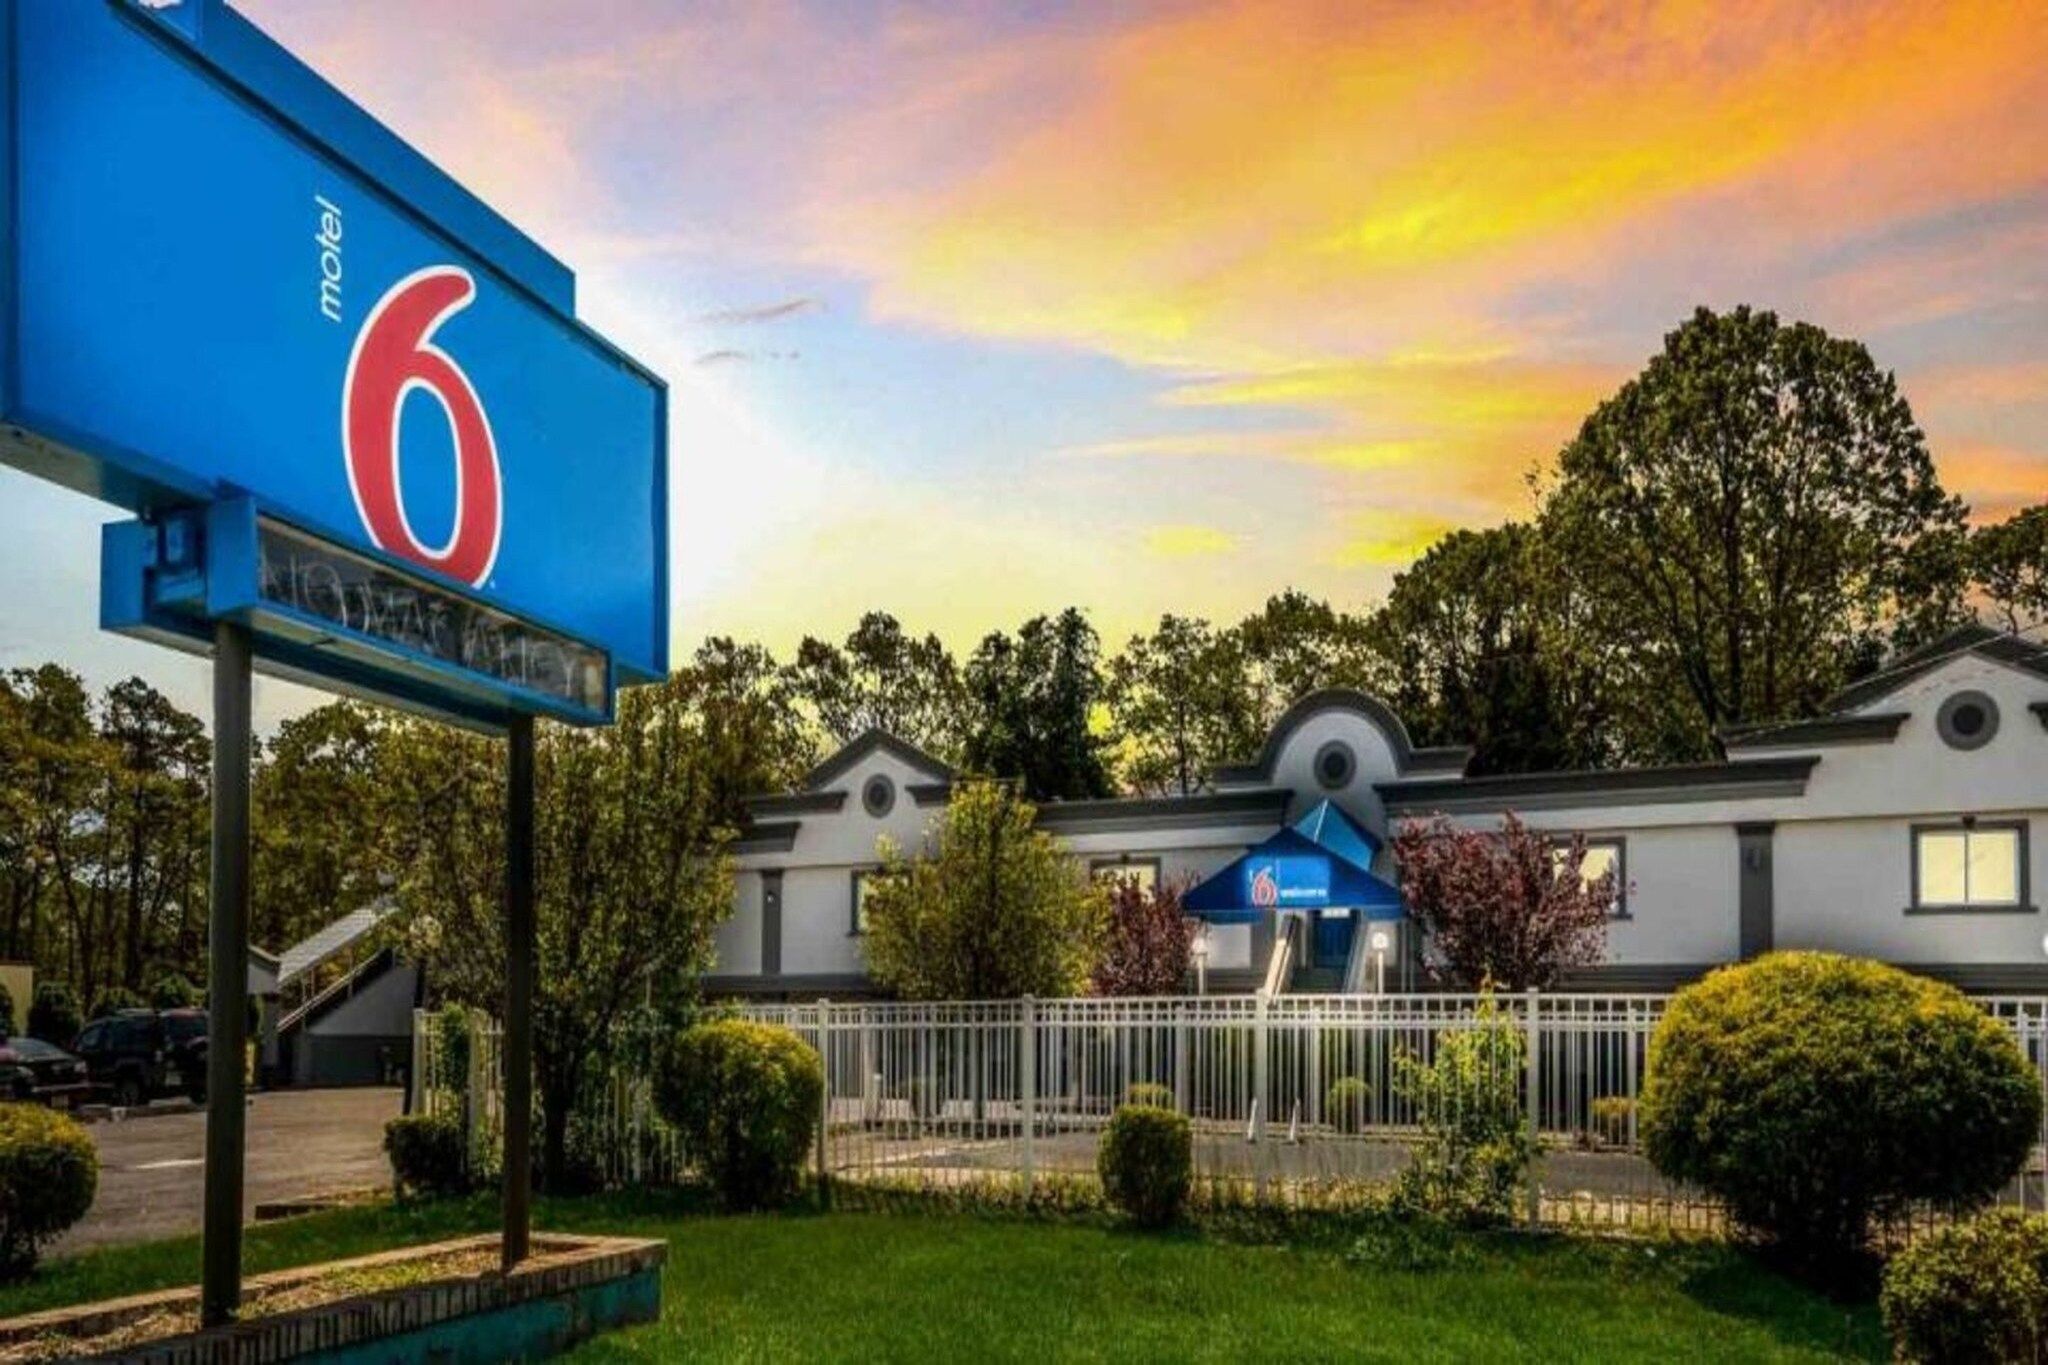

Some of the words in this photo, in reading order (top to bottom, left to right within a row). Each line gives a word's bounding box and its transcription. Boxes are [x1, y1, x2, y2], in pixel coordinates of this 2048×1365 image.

[315, 195, 342, 323] motel
[341, 264, 502, 589] 6
[1252, 865, 1278, 906] 6
